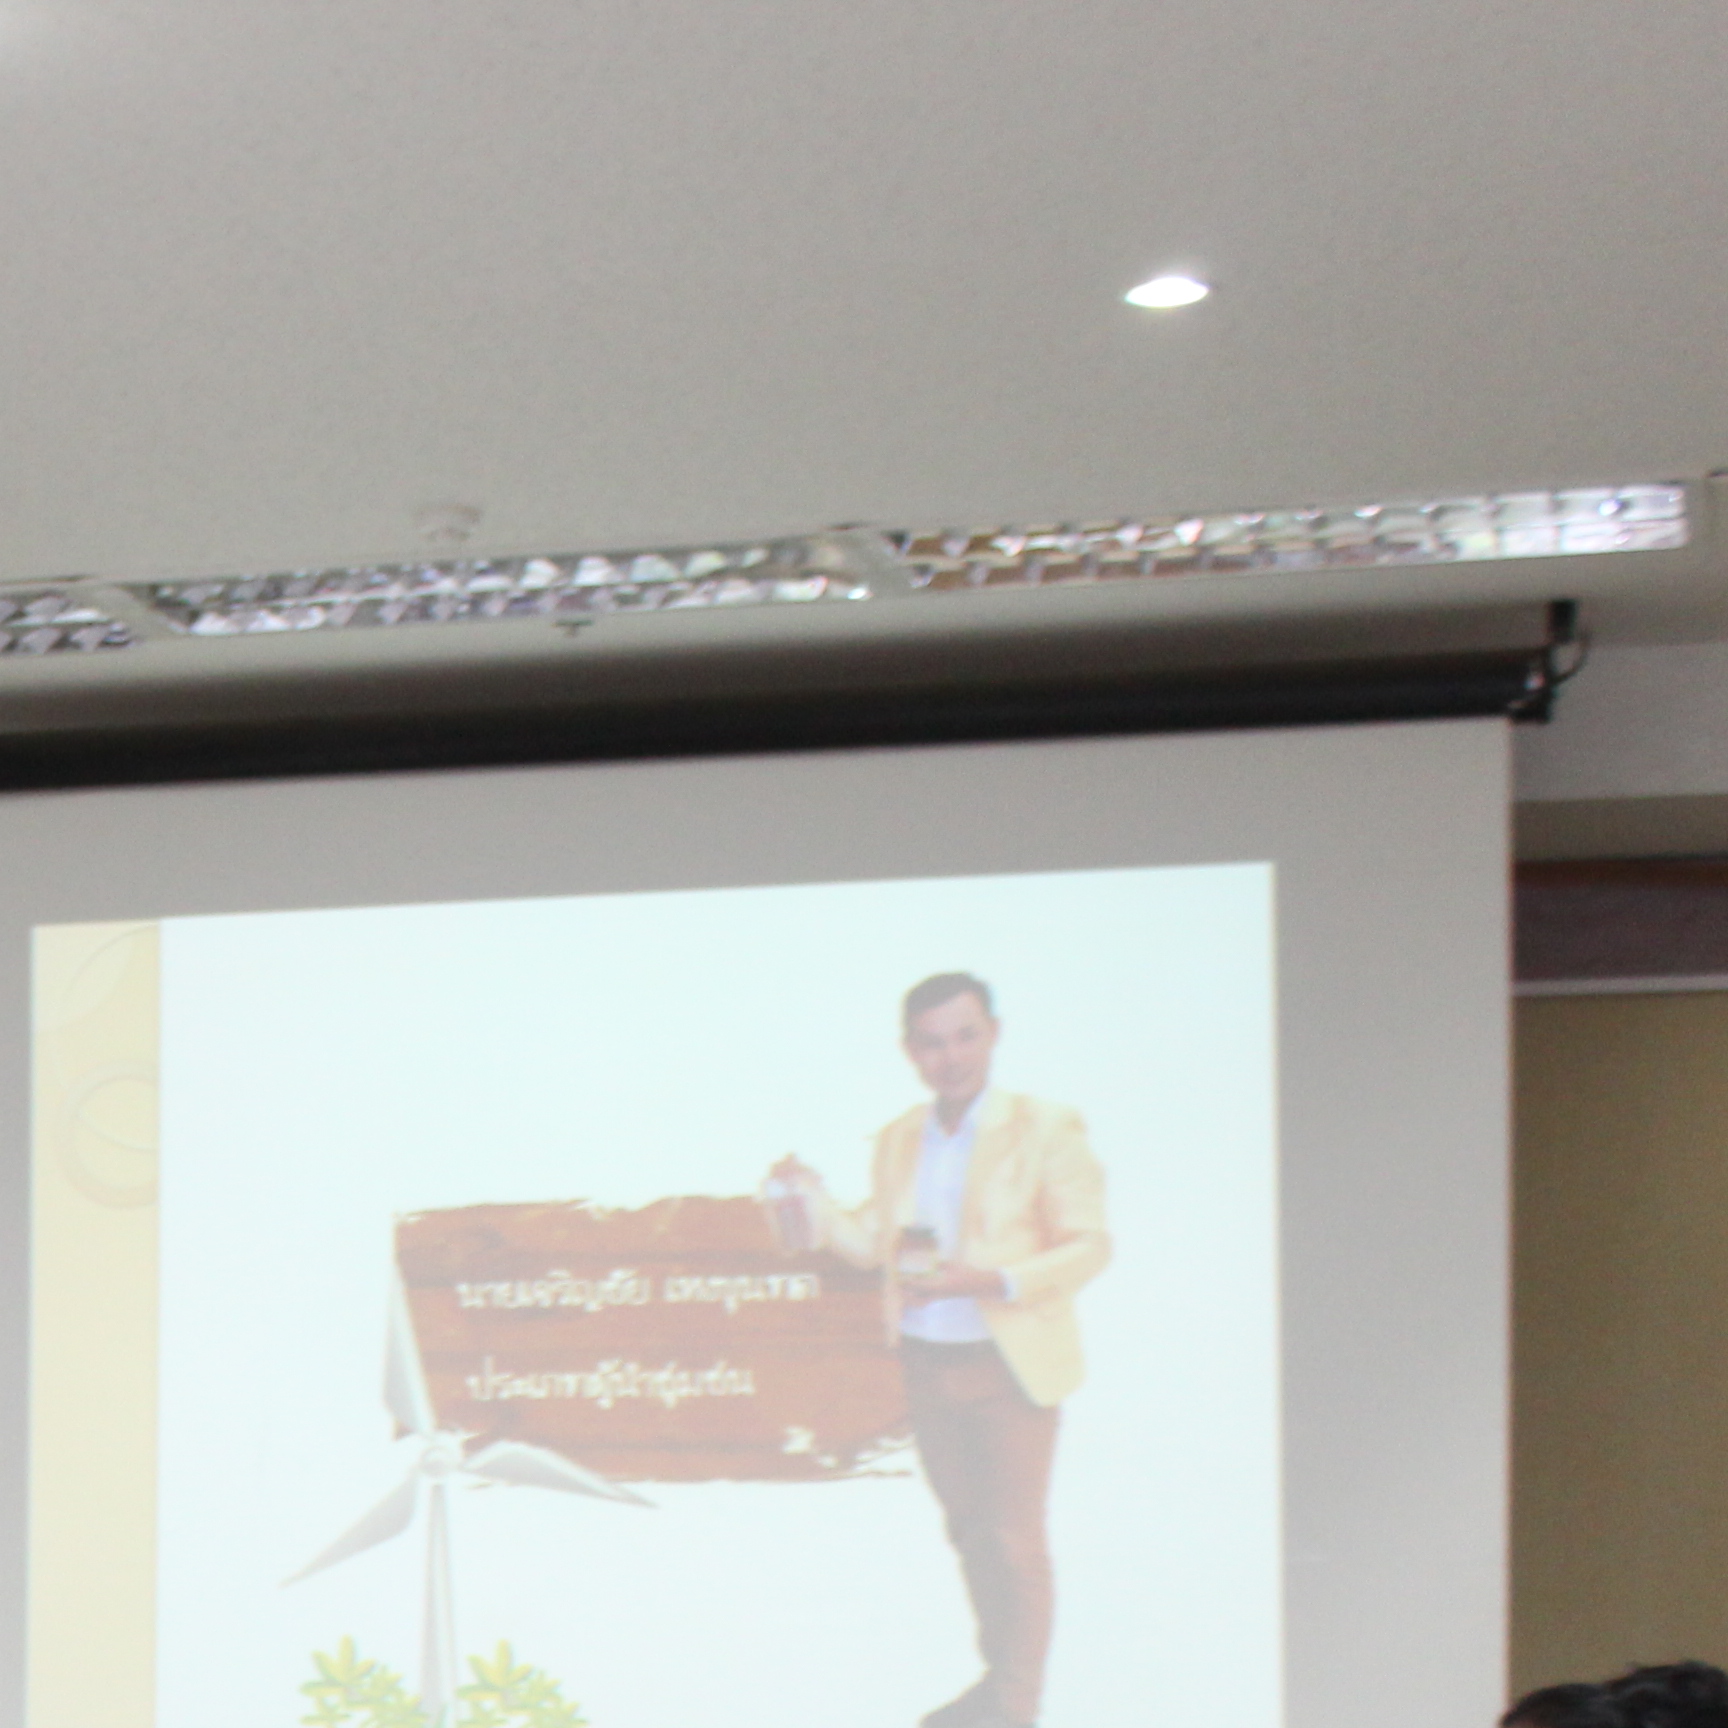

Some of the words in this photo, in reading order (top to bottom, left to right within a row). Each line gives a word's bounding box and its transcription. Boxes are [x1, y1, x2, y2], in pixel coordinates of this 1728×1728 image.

[464, 1354, 757, 1409] ประเภทผู้นำชุมชน
